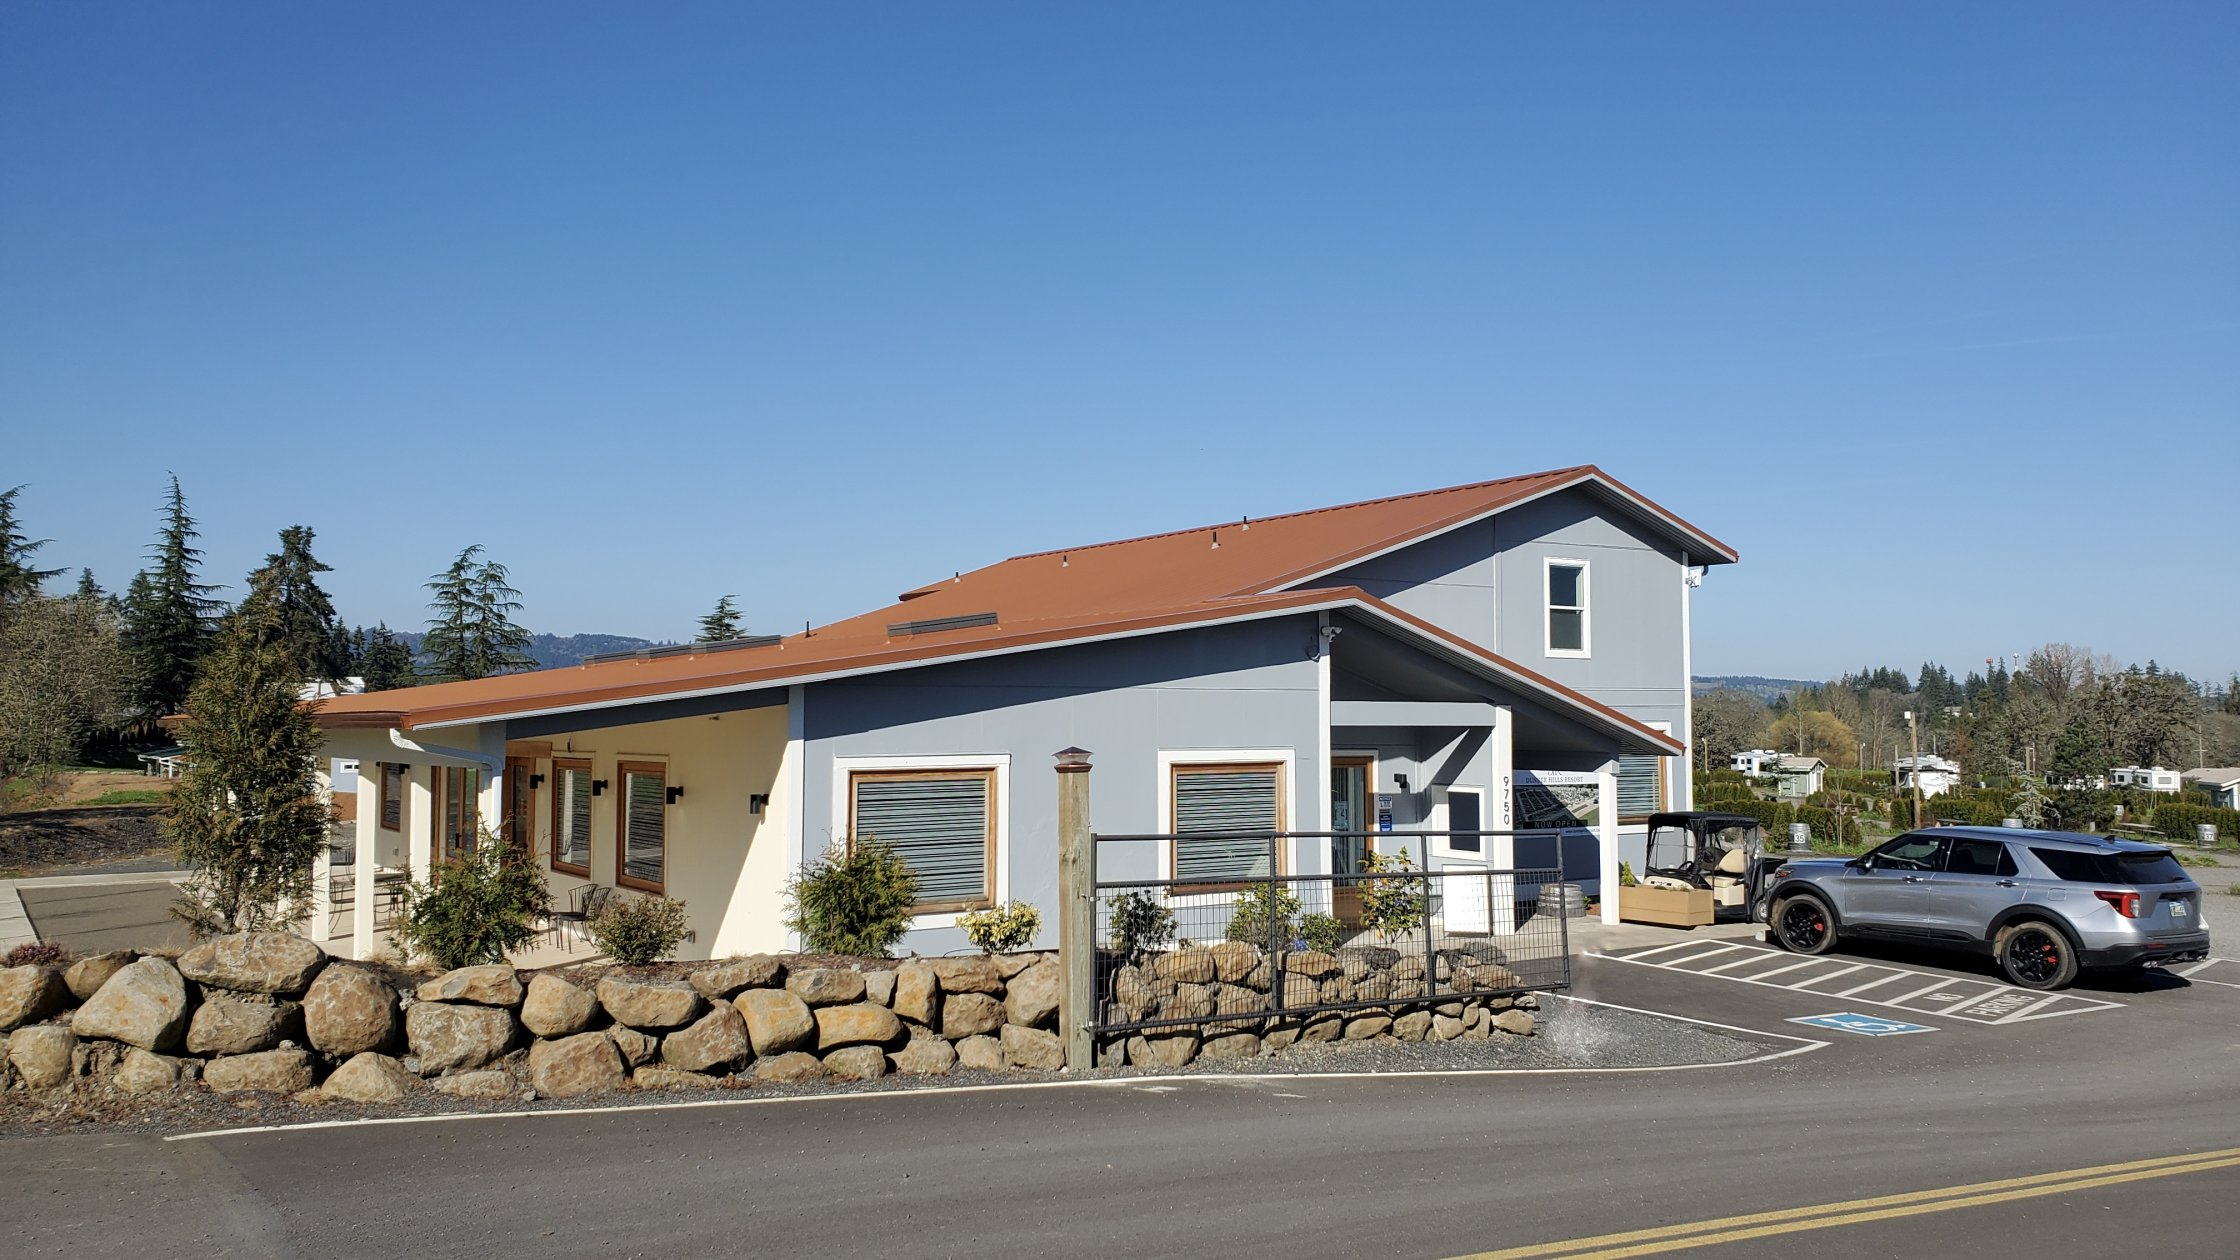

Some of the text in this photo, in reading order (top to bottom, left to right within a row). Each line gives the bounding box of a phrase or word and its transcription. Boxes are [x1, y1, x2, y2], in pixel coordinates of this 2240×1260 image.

[1534, 820, 1577, 829] NOW OPEN
[1795, 834, 1804, 842] 35
